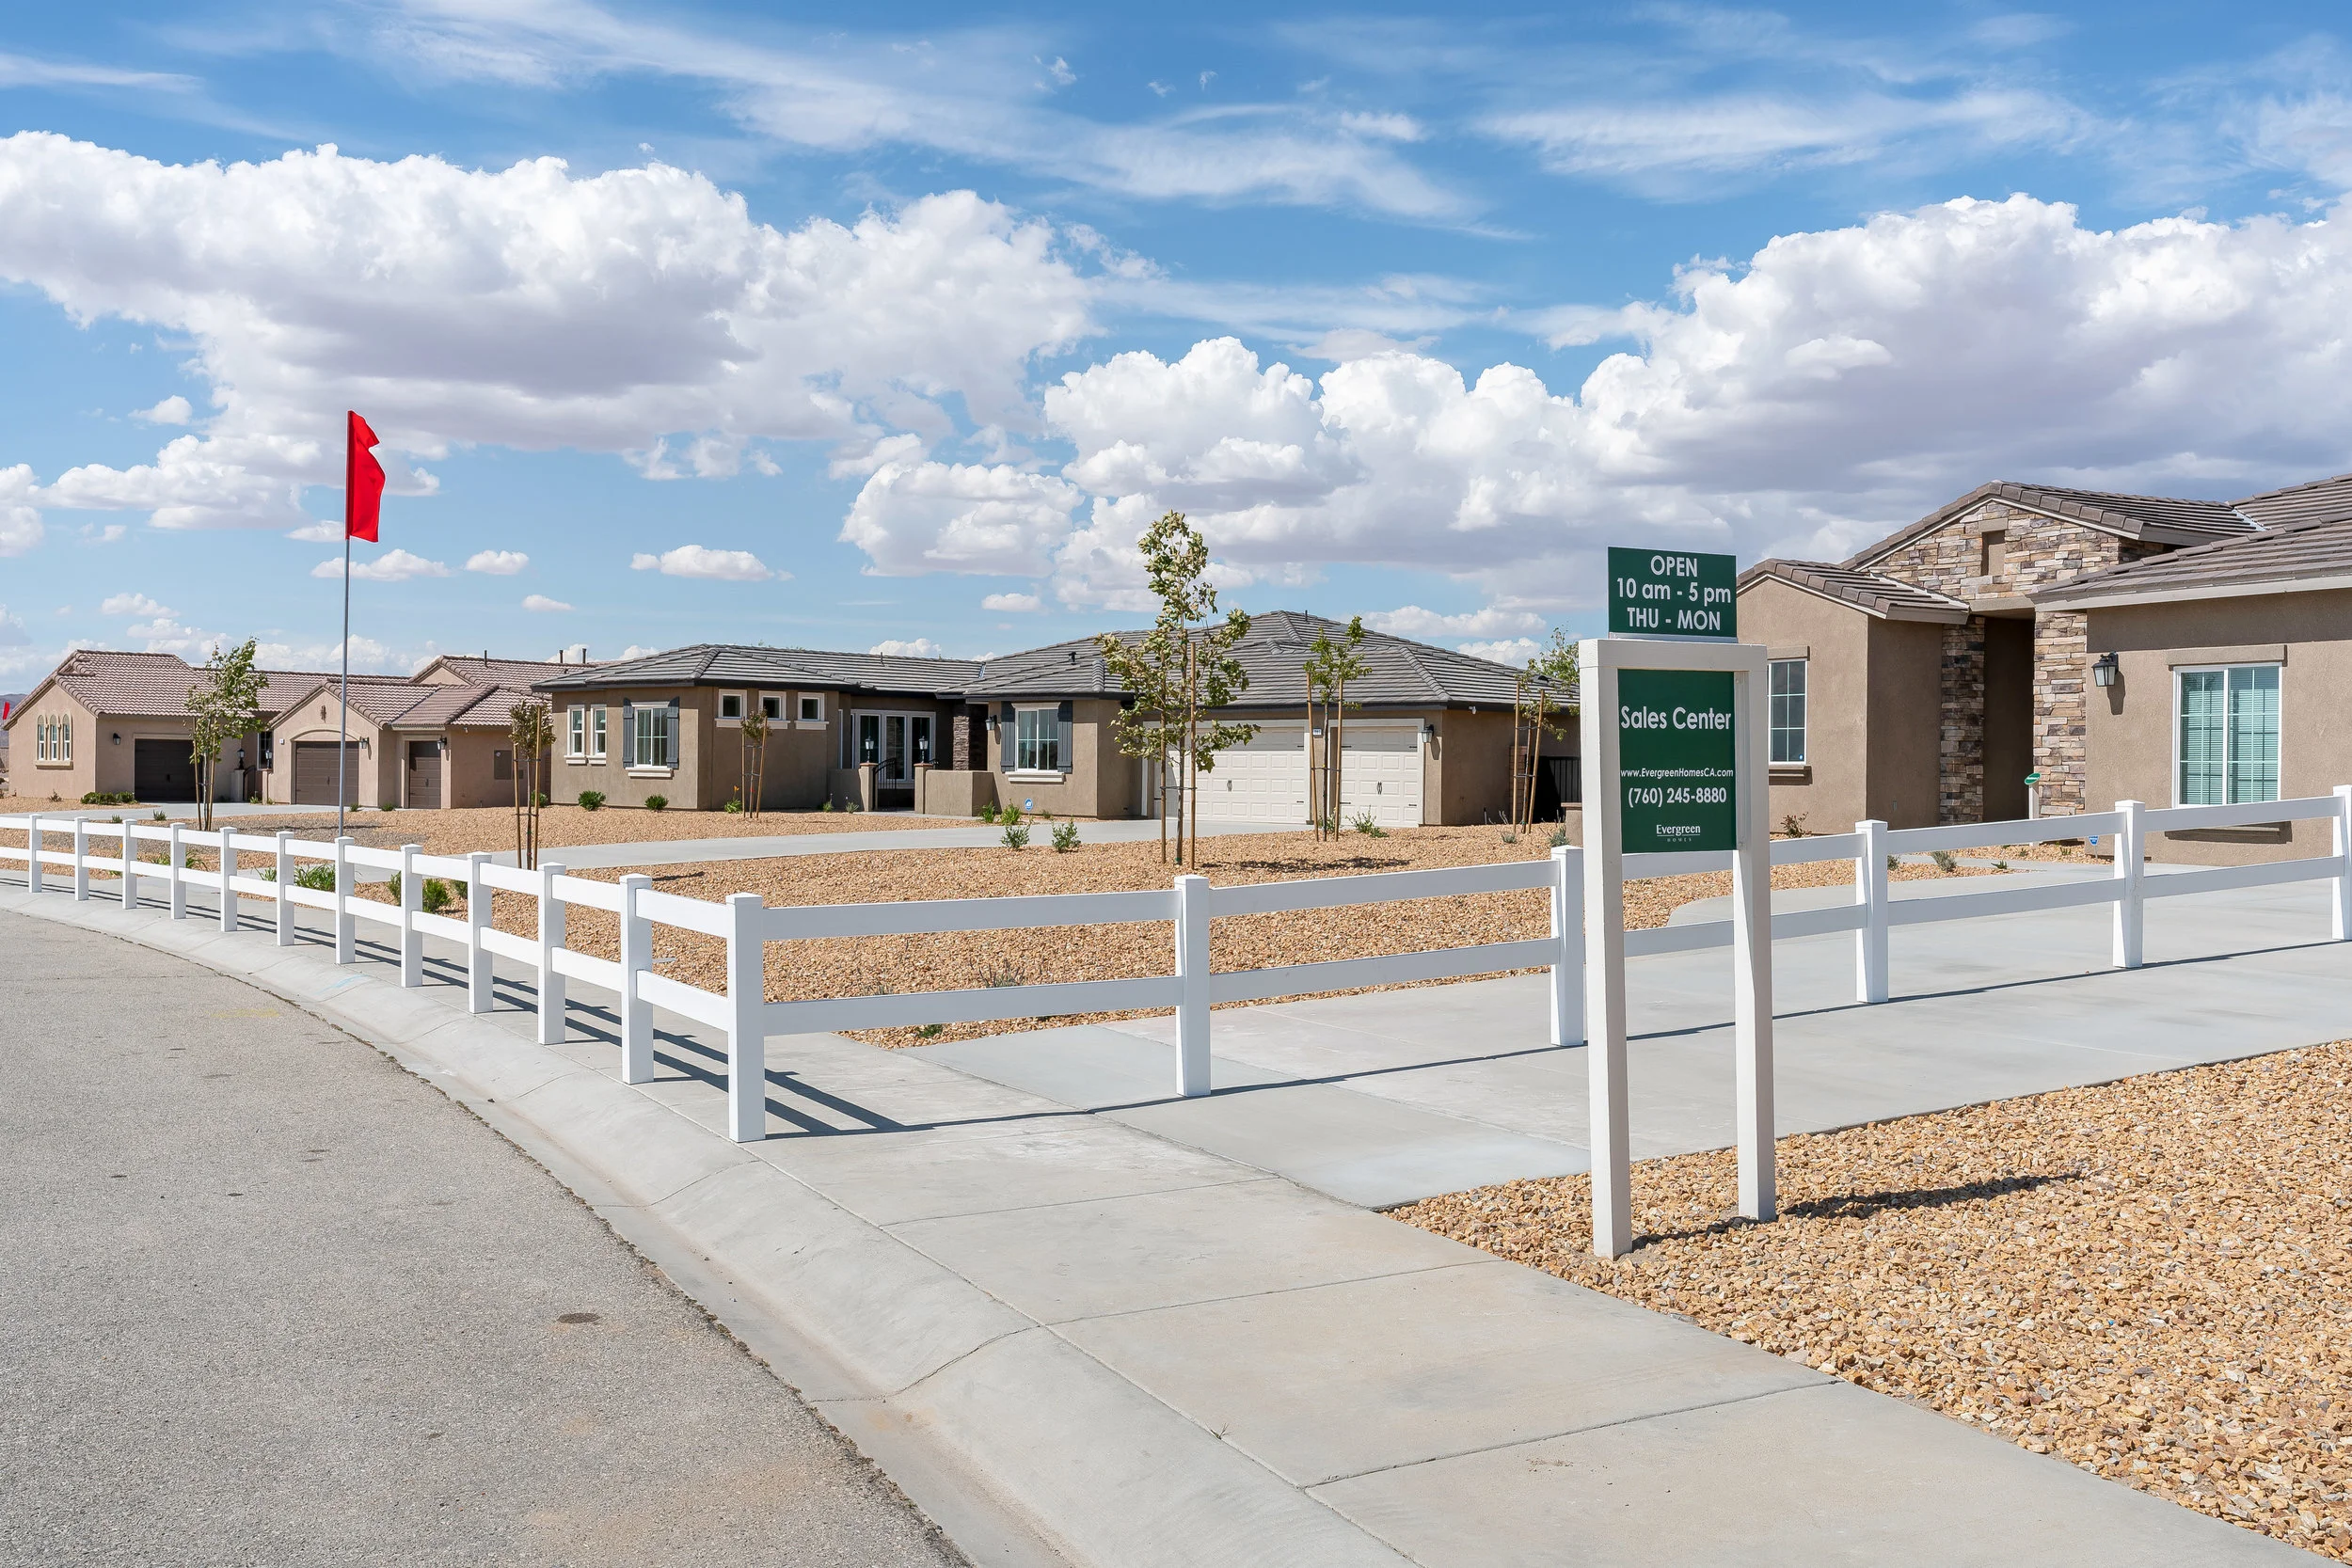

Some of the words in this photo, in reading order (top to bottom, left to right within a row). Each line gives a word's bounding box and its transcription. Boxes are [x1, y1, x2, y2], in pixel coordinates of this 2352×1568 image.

[1650, 555, 1698, 578] OPEN
[1616, 578, 1637, 598] 10
[1642, 583, 1671, 600] am
[1688, 581, 1698, 602] 5
[1704, 587, 1731, 607] pm
[1627, 607, 1659, 628] THU
[1677, 610, 1721, 631] MON
[1620, 705, 1668, 729] Sales
[1672, 706, 1732, 730] Center
[1620, 768, 1734, 780] www.EvergreenHomesCA.com
[1628, 787, 1663, 808] (760)
[1666, 787, 1727, 804] 245-8880
[1656, 824, 1701, 836] Evergreen
